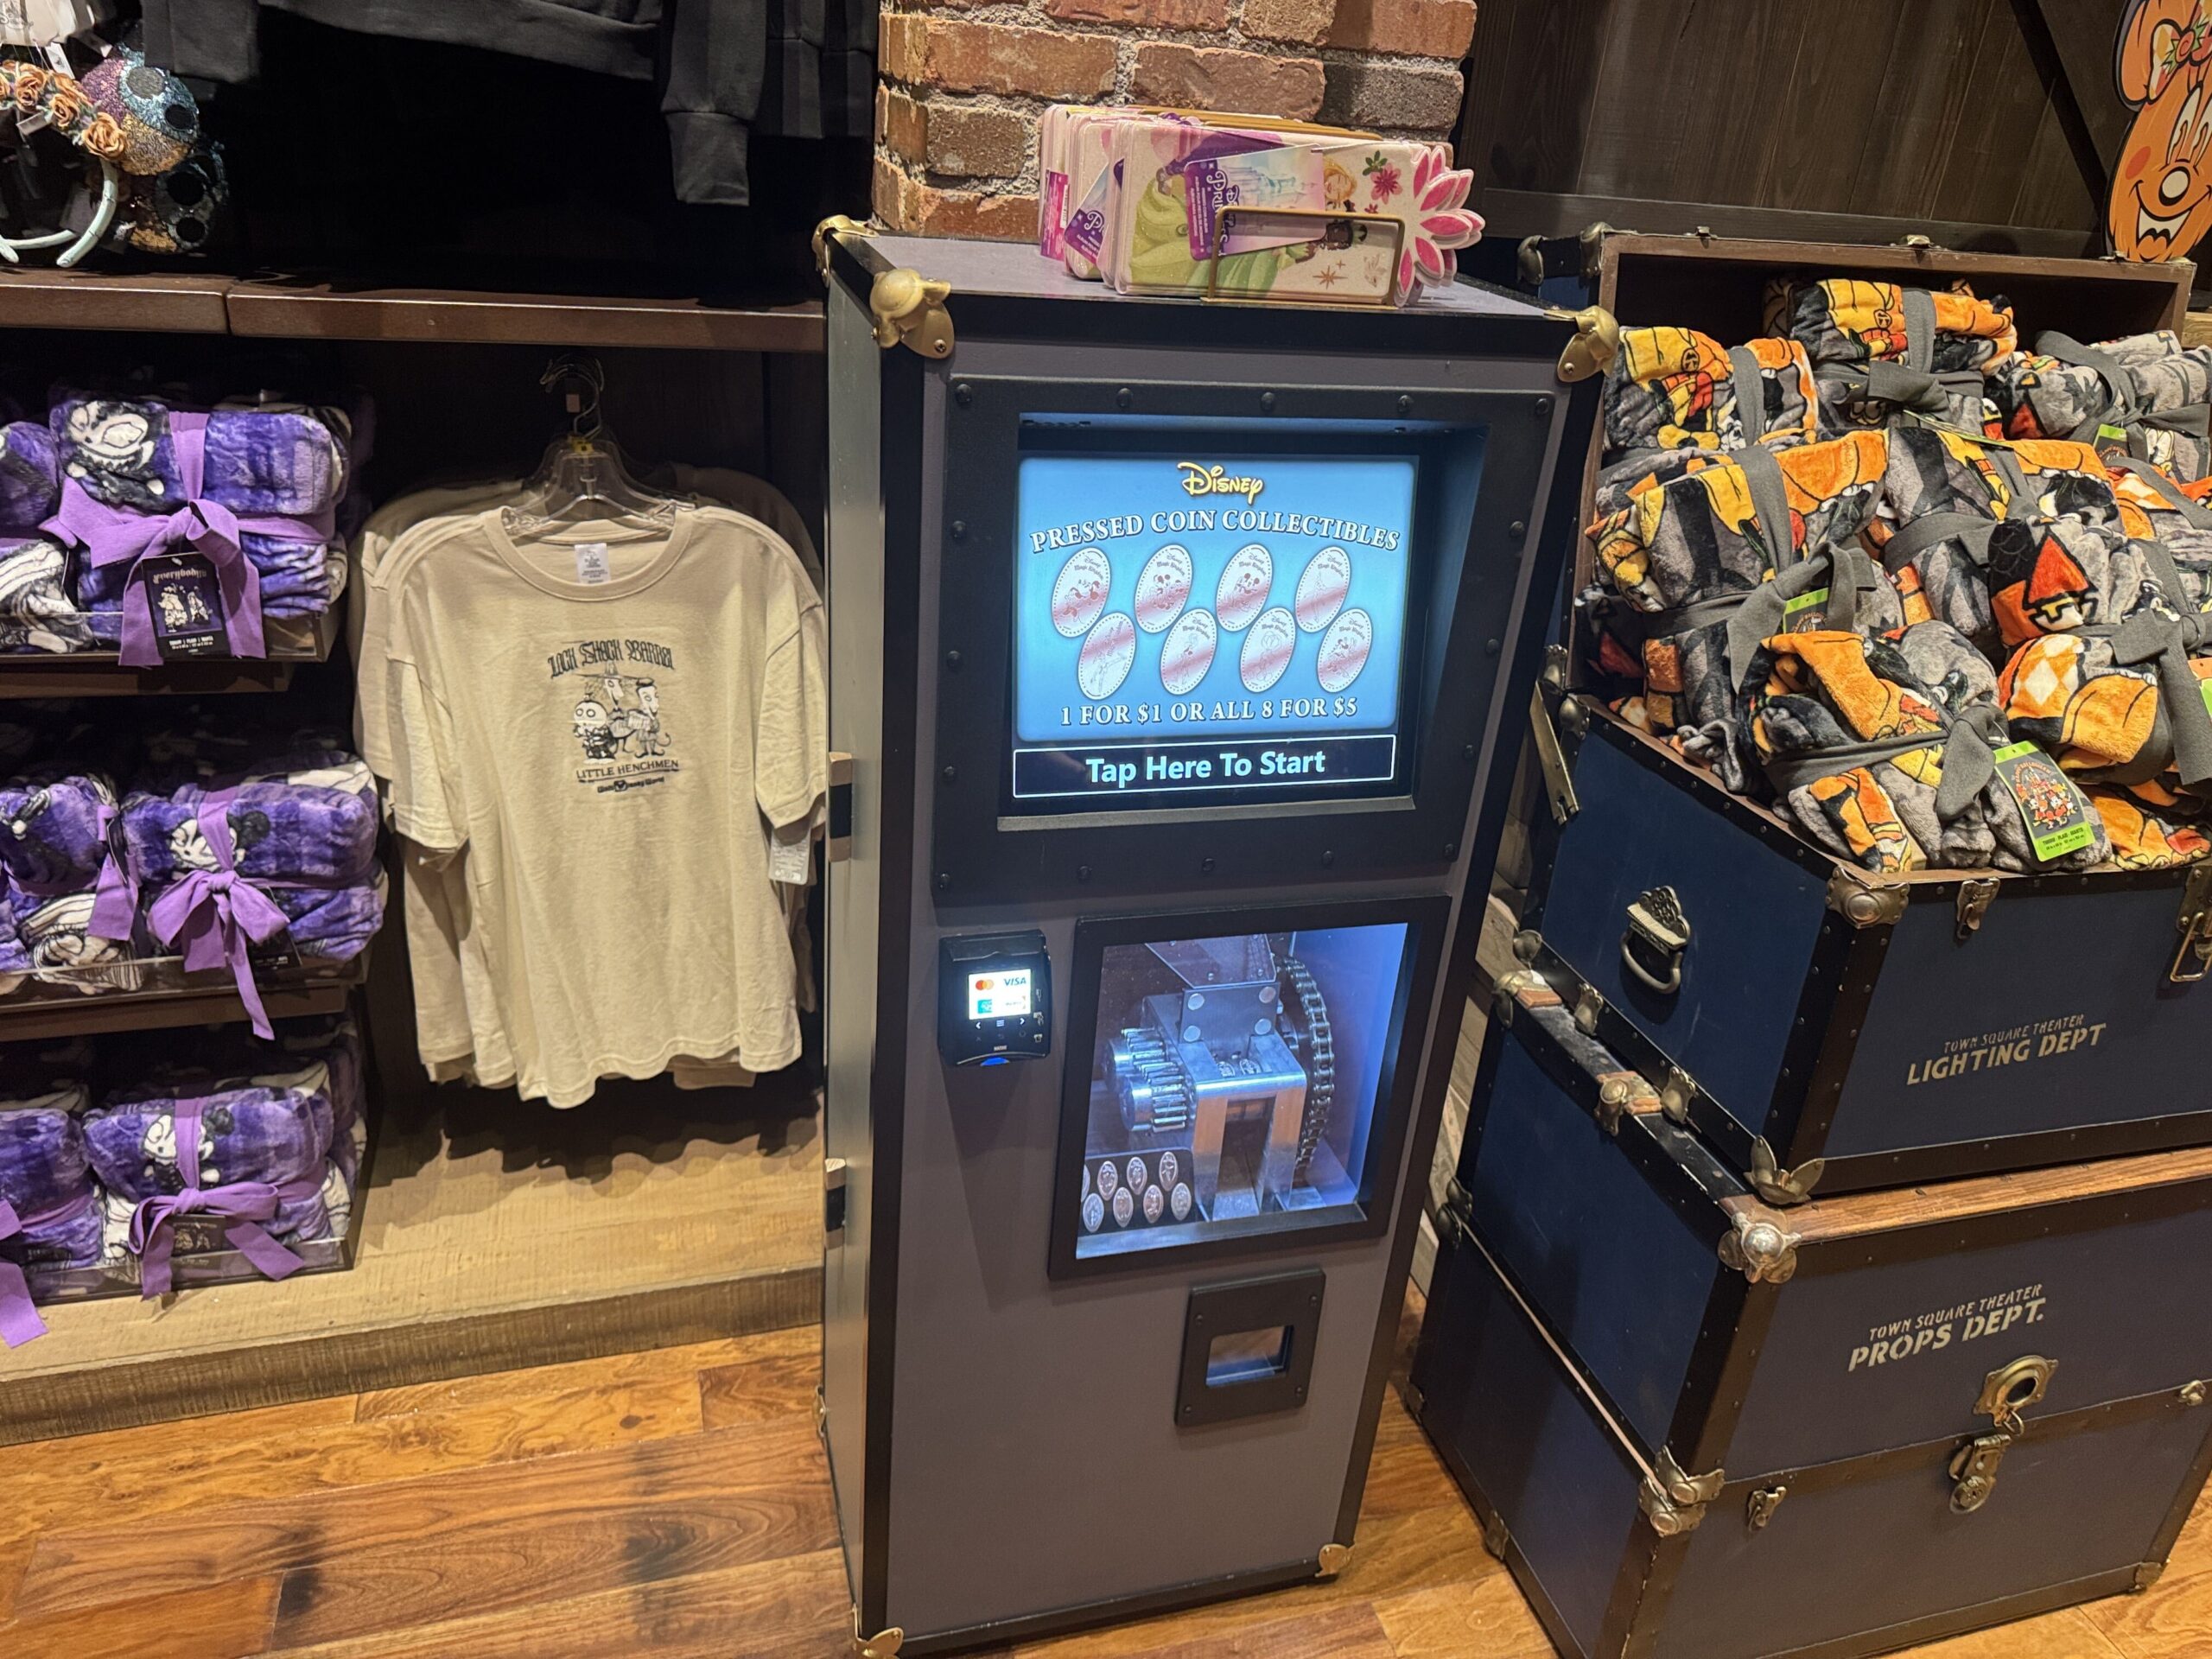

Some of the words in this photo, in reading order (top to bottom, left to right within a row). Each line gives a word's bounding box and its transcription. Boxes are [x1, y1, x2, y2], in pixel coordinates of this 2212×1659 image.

[1177, 461, 1263, 505] Disney
[1030, 513, 1144, 554] PRESSED
[1151, 509, 1216, 535] COIN
[1222, 509, 1401, 550] COLLECTIBLES
[1061, 707, 1071, 726] 1
[1080, 704, 1130, 725] FOR
[1137, 702, 1161, 724] $1
[1170, 702, 1205, 722] OR
[1210, 700, 1255, 721] ALL
[1262, 699, 1274, 718] 8
[1280, 698, 1326, 718] FOR
[1333, 696, 1357, 716] $5
[576, 768, 614, 779] LITTLE
[618, 760, 678, 774] HENCHMEN
[1086, 758, 1136, 788] Tap
[1147, 754, 1211, 779] Here
[1219, 753, 1251, 777] To
[1260, 750, 1325, 775] Start
[1003, 976, 1027, 987] VISA
[1906, 1039, 2031, 1085] LIGHTING
[2037, 1023, 2107, 1058] DEPT
[1944, 1037, 1978, 1053] TOWN
[1980, 1025, 2030, 1046] SQUARE
[2033, 1014, 2084, 1035] THEATER
[1870, 1319, 1911, 1341] TOWN
[1915, 1301, 1975, 1329] SQUARE
[1979, 1283, 2043, 1313] THEATER
[1848, 1323, 1953, 1372] PROPS
[1961, 1297, 2046, 1341] DEPT.
